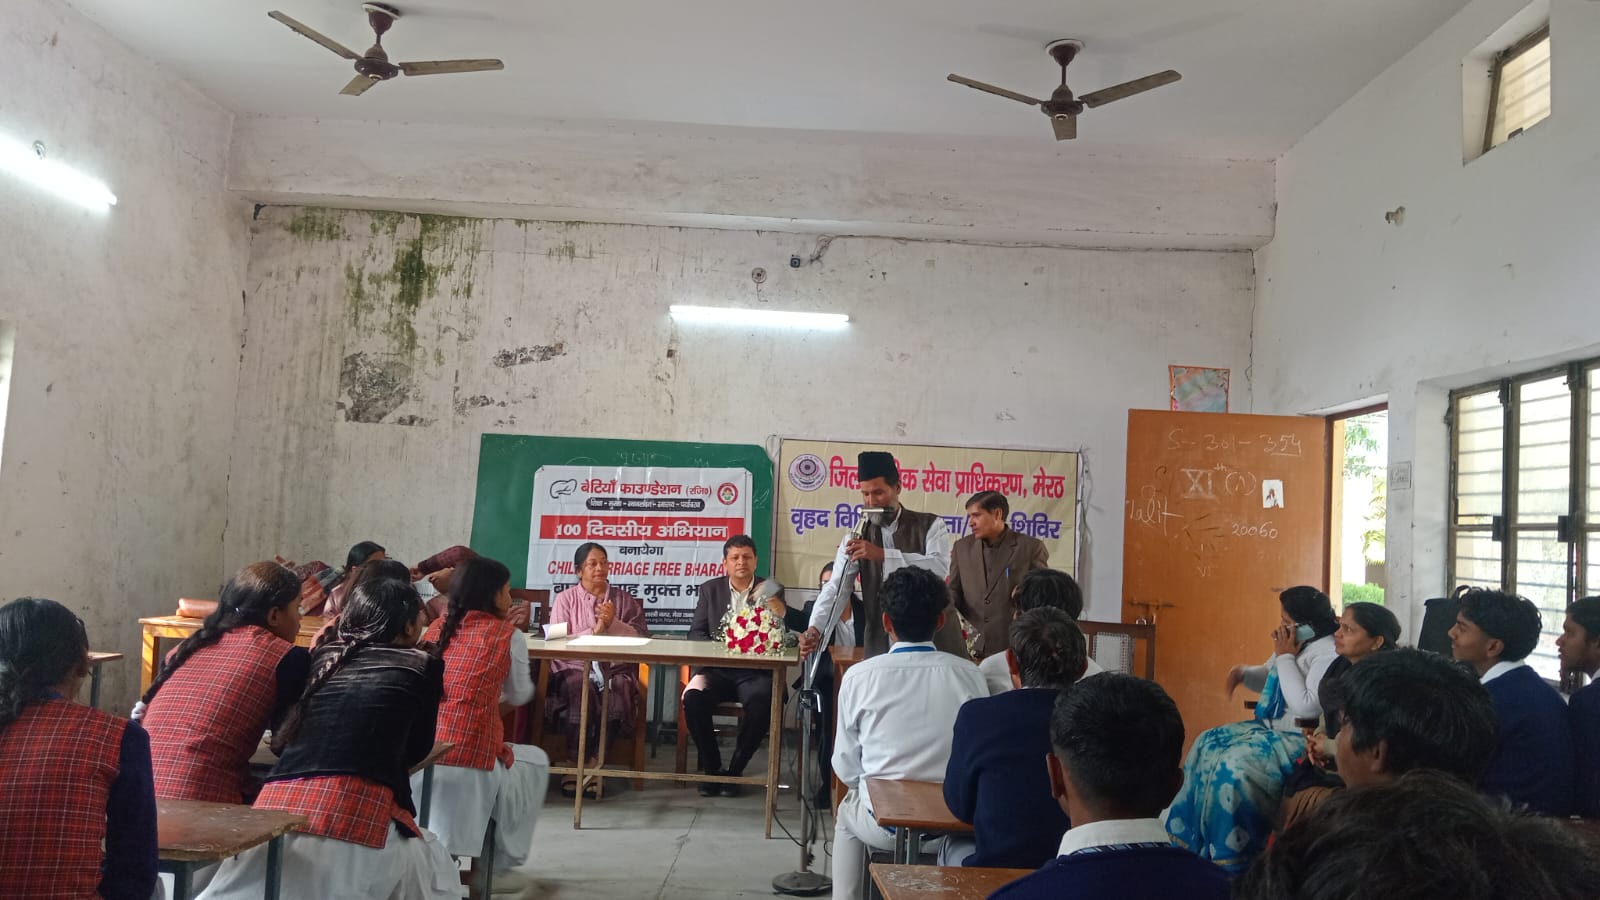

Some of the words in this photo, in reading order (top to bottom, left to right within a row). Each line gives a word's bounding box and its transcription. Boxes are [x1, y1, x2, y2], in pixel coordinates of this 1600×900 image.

[581, 479, 616, 494] बेटियाँ
[620, 480, 682, 496] फाउण्डेशन
[922, 461, 951, 493] सेवा
[955, 462, 1028, 498] प्राधिकरण,
[1033, 467, 1066, 499] मेरठ
[556, 523, 581, 537] 100
[586, 520, 652, 538] दिवसीय
[656, 521, 728, 539] अभियान
[791, 508, 831, 535] वृहद
[1010, 511, 1062, 540] शिविर
[619, 543, 664, 556] बनायेगा
[547, 560, 577, 575] CHIL
[653, 562, 682, 577] FREE
[684, 562, 729, 577] BHARA
[643, 584, 681, 604] मुक्त
